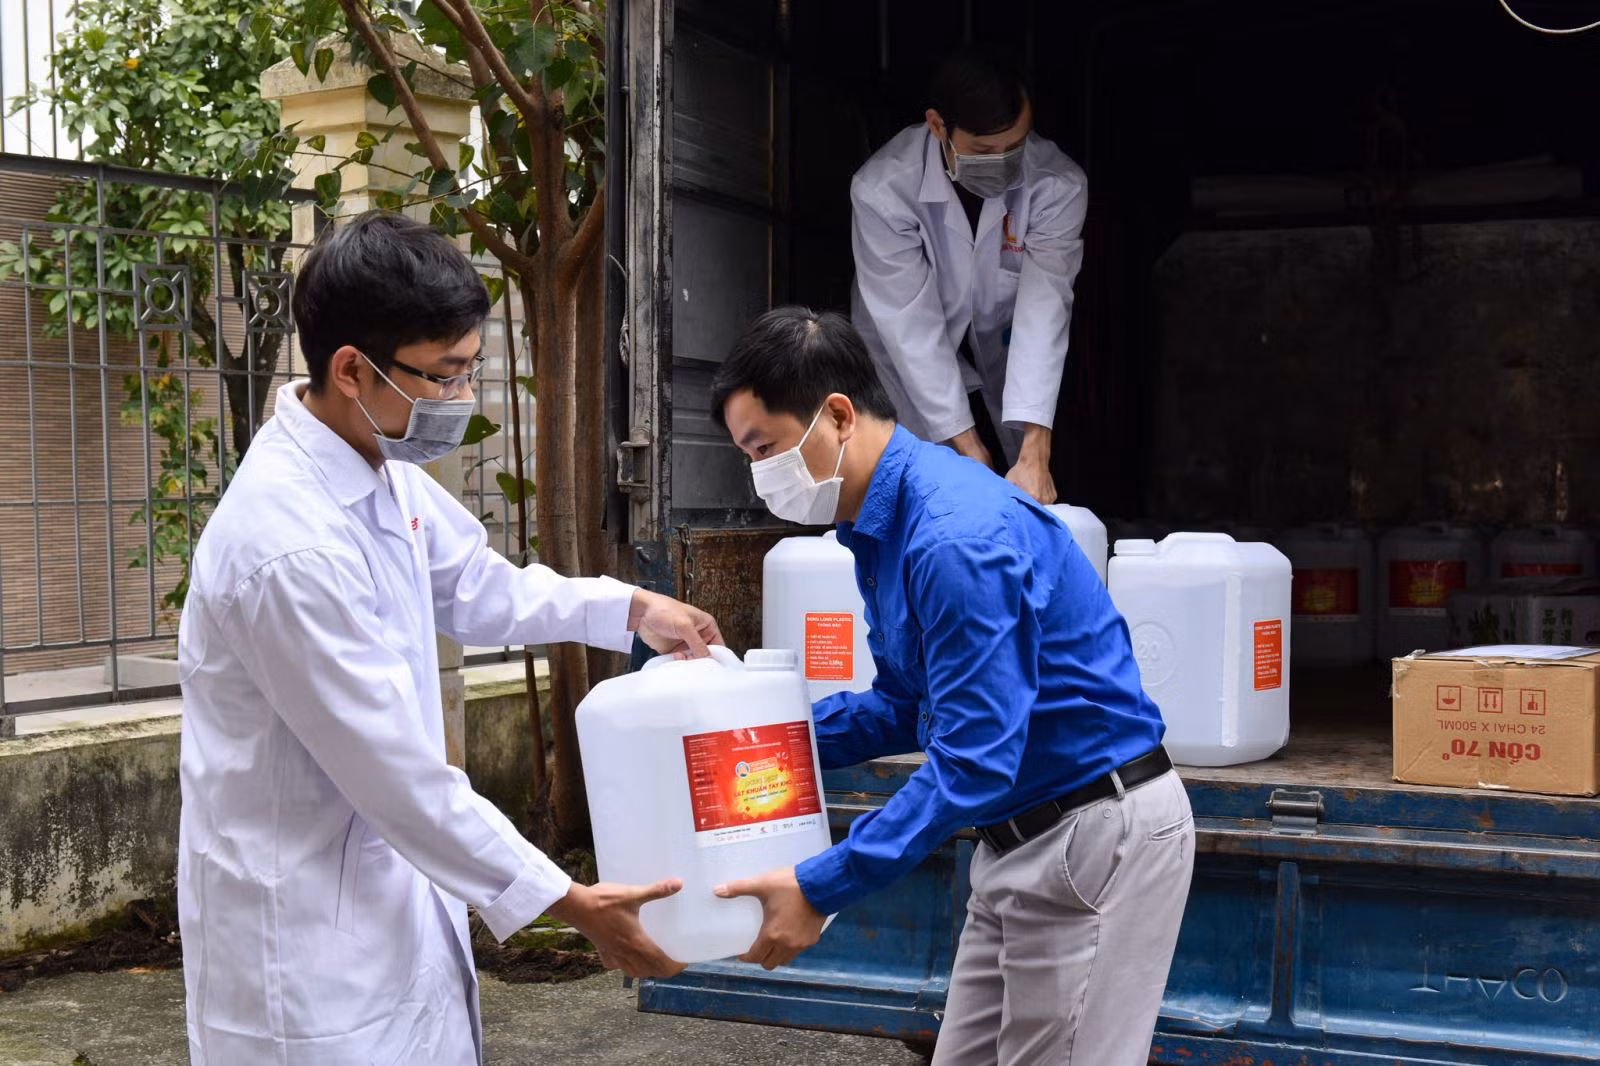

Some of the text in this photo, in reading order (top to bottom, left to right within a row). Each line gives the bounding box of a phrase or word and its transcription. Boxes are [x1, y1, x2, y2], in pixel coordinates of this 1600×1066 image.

[1138, 640, 1160, 661] 20
[1437, 720, 1546, 735] 24 CHAI X 500ML
[1488, 741, 1541, 765] CỒN
